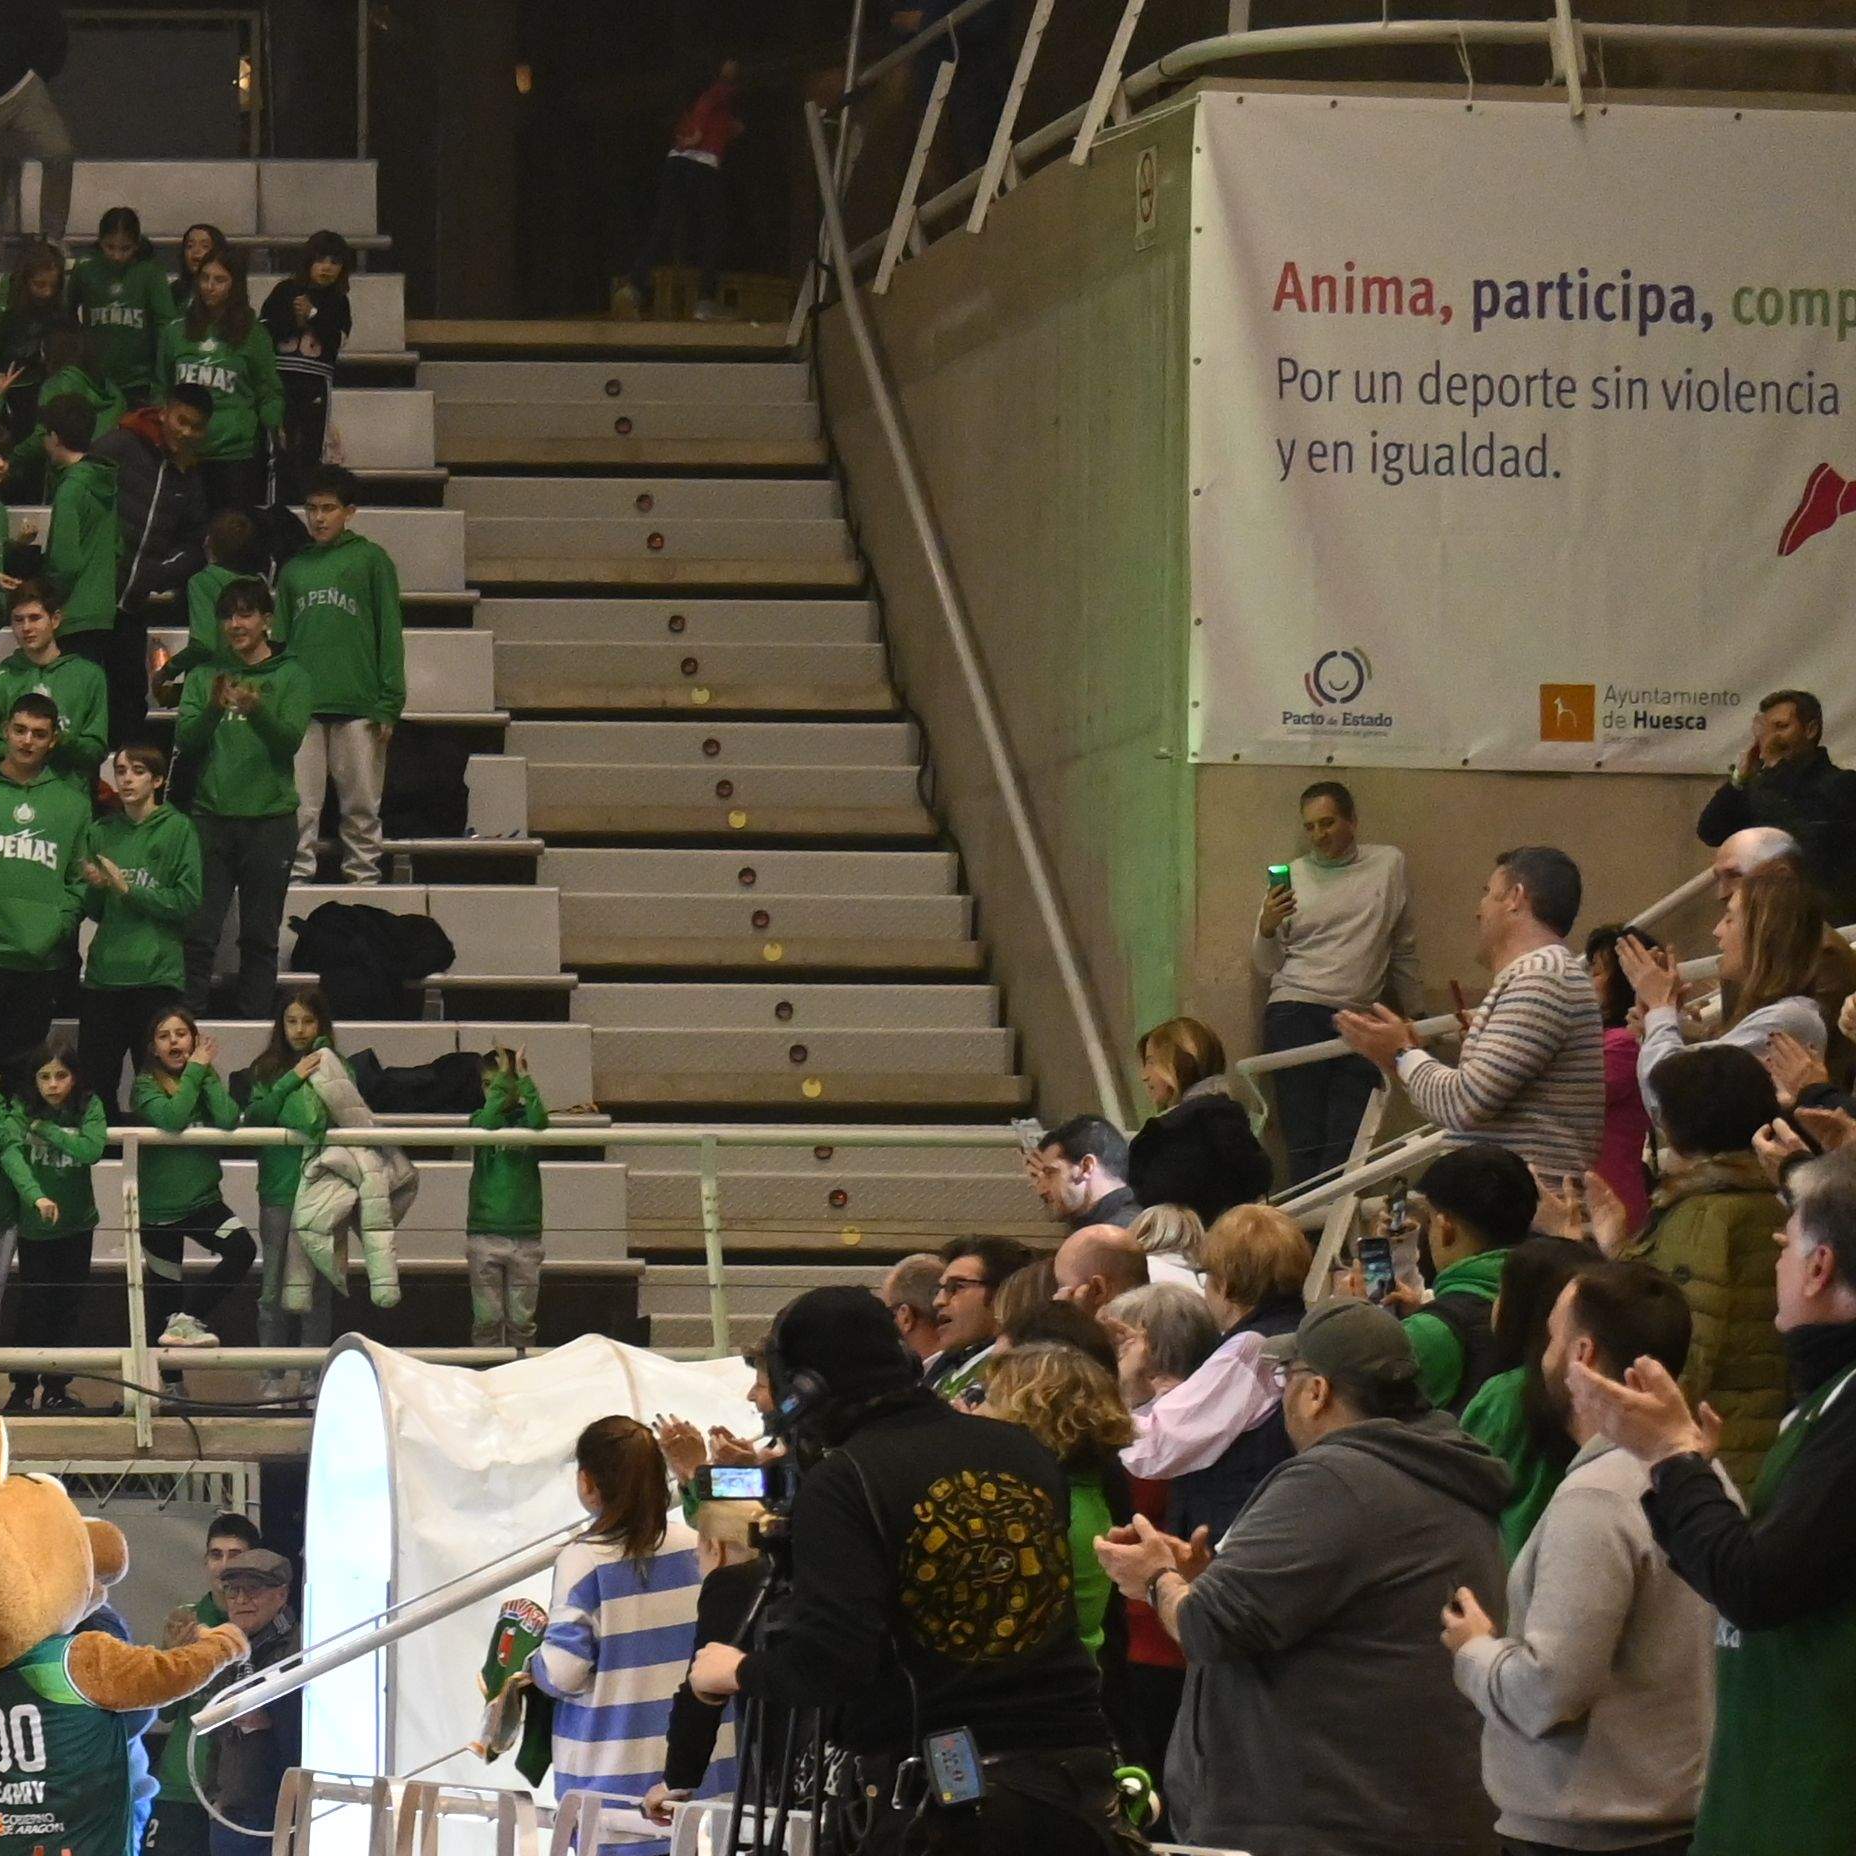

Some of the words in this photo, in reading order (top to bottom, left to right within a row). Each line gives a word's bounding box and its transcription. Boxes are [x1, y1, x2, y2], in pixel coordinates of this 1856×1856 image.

[1272, 261, 1454, 326] Anima,
[1472, 267, 1714, 337] participa,
[1732, 285, 1856, 342] comp
[1277, 356, 1341, 403] Por
[1354, 369, 1403, 404] un
[1418, 358, 1577, 418] deporte
[1591, 364, 1648, 410] sin
[1660, 366, 1840, 416] violencia
[1276, 438, 1296, 482] y
[1307, 439, 1354, 474] en
[1370, 430, 1561, 486] igualdad.
[1603, 684, 1742, 709] Ayuntamiento
[1282, 710, 1325, 726] Pacto
[1341, 711, 1393, 728] Estado
[1603, 710, 1627, 729] de
[1633, 710, 1707, 730] Huesca
